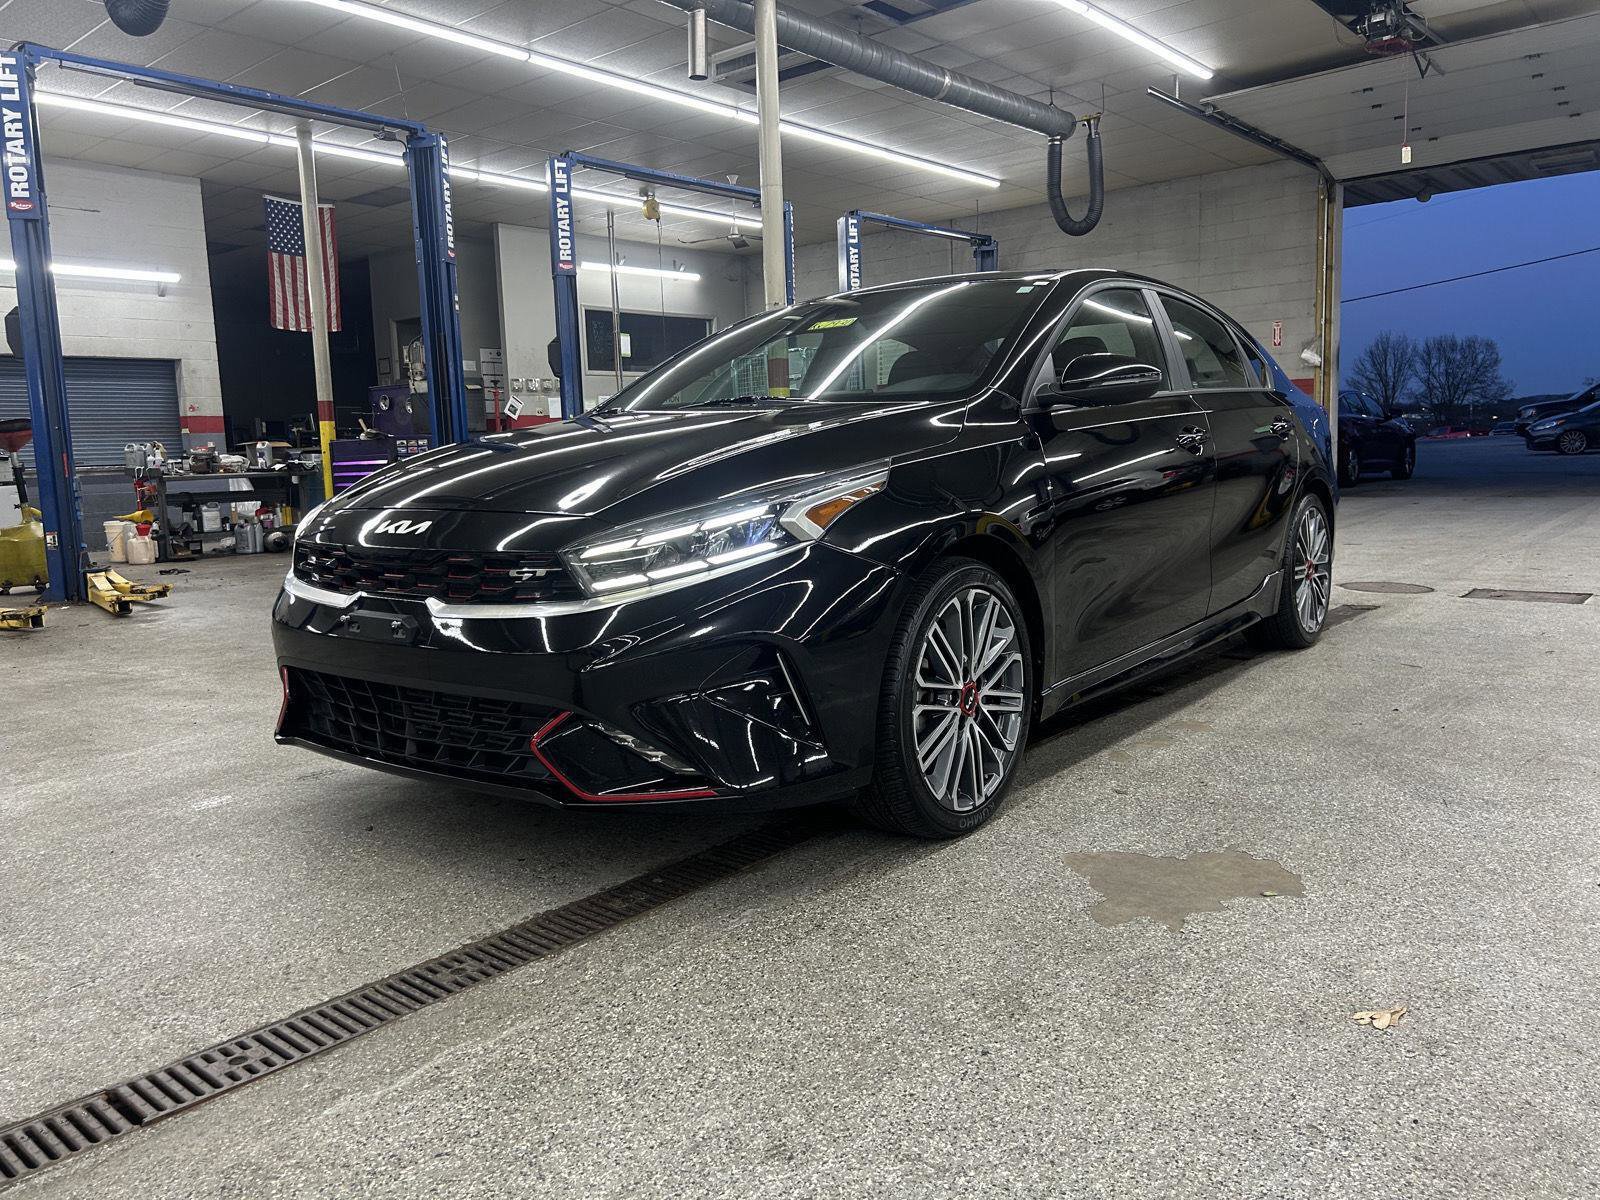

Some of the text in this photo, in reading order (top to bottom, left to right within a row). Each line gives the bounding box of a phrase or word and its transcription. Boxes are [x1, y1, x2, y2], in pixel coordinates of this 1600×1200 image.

[0, 53, 30, 198] ROTARY LIFT
[440, 136, 450, 174] LIFT
[554, 159, 568, 193] LIFT
[443, 178, 455, 249] ROTARY
[556, 197, 572, 261] ROTARY
[848, 217, 861, 291] OTARY LIFT
[508, 567, 547, 581] GT
